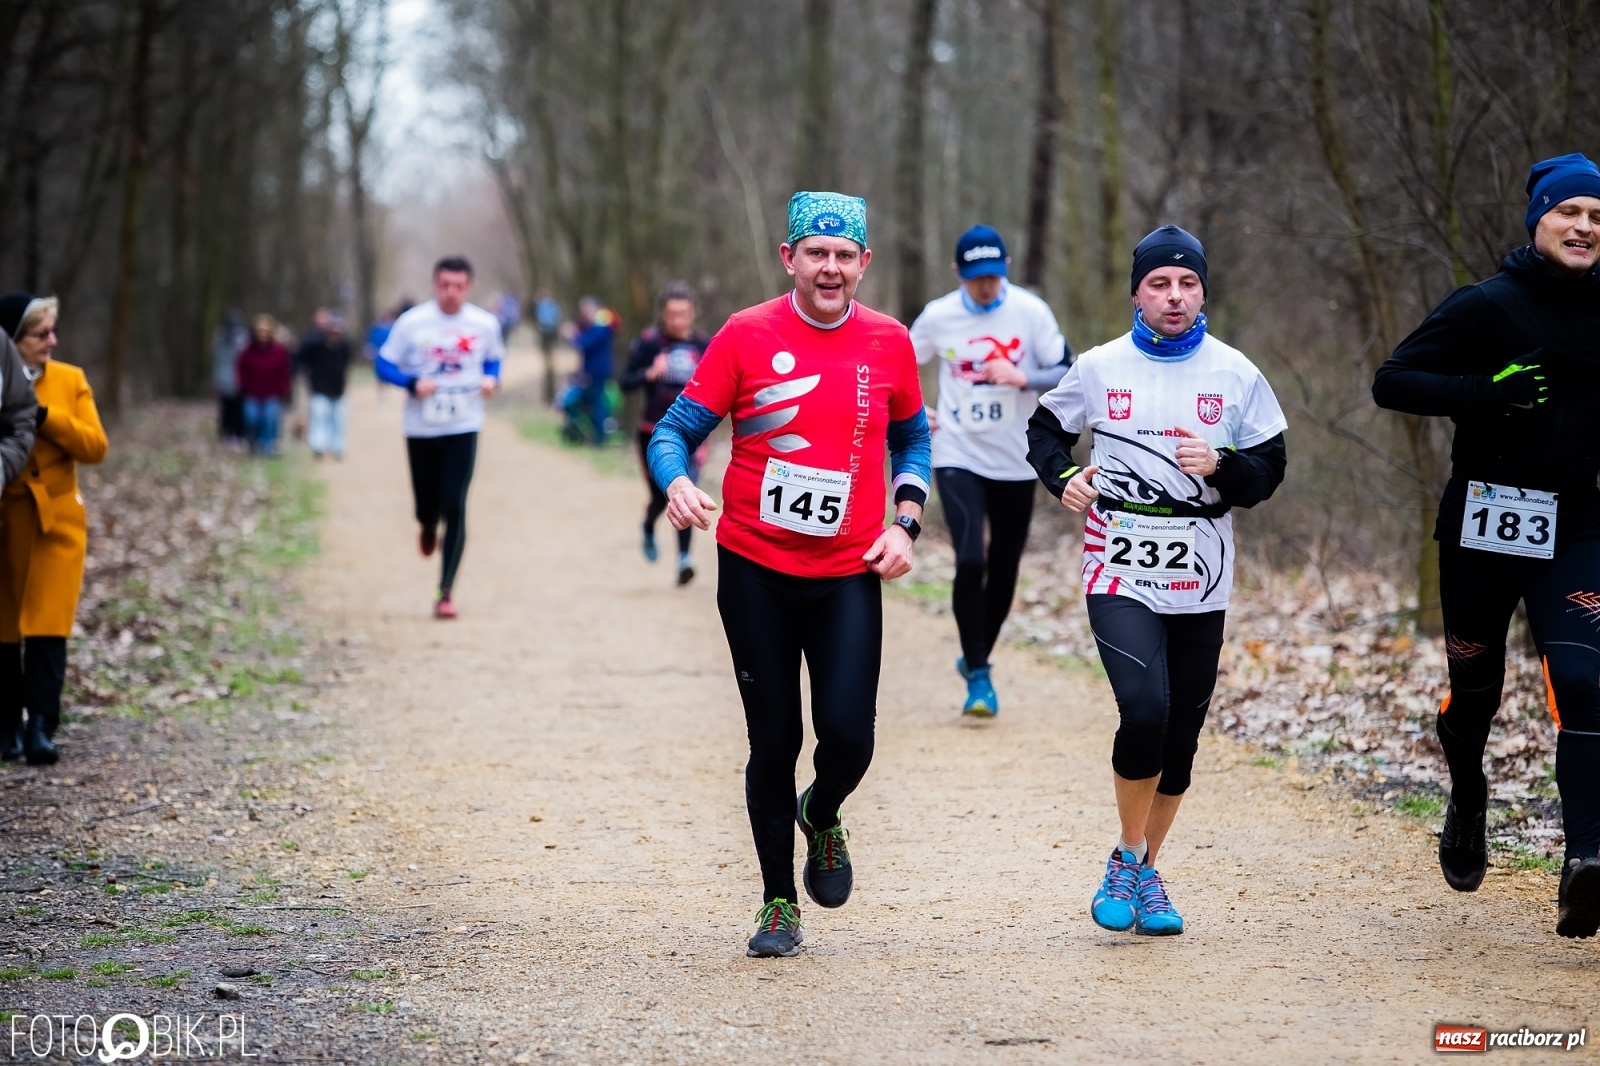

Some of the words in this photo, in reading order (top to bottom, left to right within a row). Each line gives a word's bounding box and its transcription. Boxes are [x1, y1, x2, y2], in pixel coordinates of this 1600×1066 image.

[852, 364, 870, 448] ATHLETICS
[971, 402, 1002, 421] 58
[793, 472, 848, 486] www.personalbest.pl
[767, 485, 841, 525] 145
[1137, 523, 1192, 531] www.personalbest.pl
[1471, 507, 1550, 546] 183
[1110, 536, 1189, 570] 232
